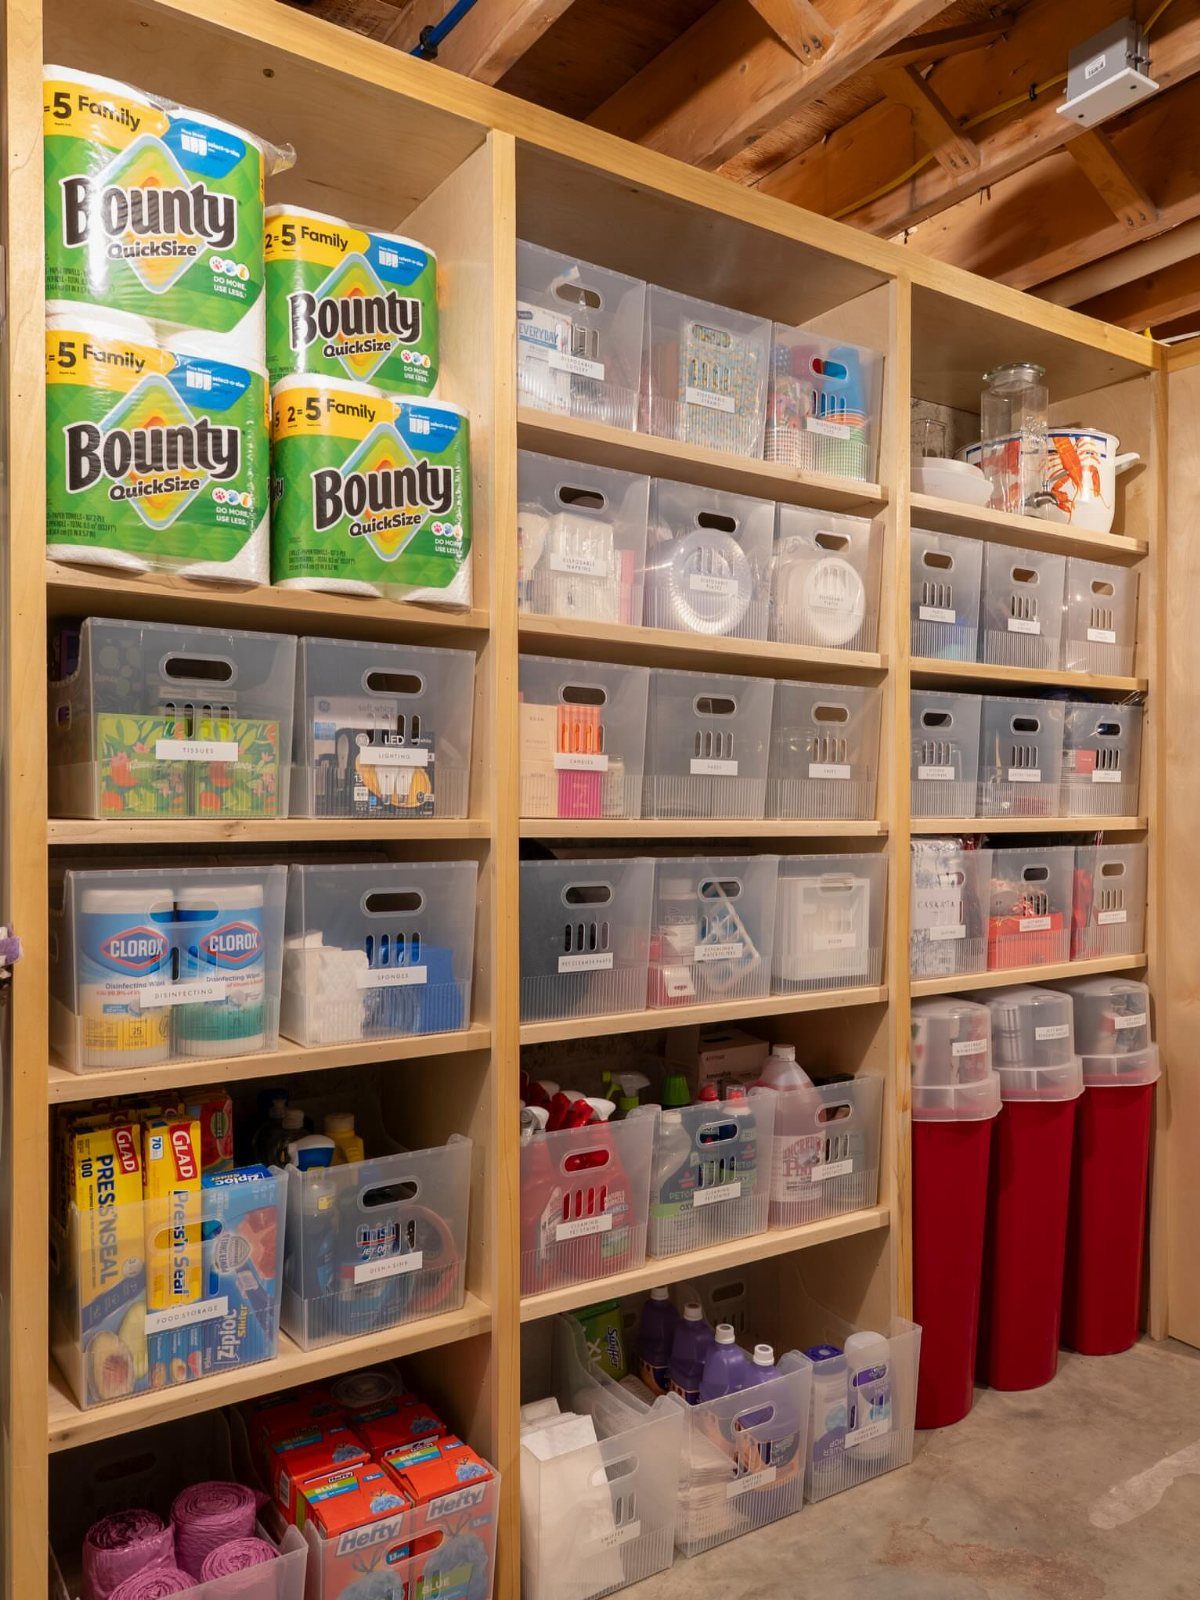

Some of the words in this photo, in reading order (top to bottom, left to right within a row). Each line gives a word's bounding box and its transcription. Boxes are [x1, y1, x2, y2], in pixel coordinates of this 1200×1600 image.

[78, 95, 141, 132] Family
[62, 176, 235, 249] Bounty
[301, 226, 349, 252] Family
[108, 240, 198, 259] QuickSize
[213, 276, 225, 285] DO
[213, 285, 227, 294] USE
[289, 290, 420, 350] Bounty
[519, 323, 559, 345] EVERYDAY
[83, 344, 145, 374] Family
[323, 340, 391, 358] QuickSize
[326, 398, 376, 423] Family
[67, 418, 239, 491] Bounty
[110, 477, 200, 500] QuickSize
[313, 460, 452, 530] Bounty
[216, 506, 227, 515] DO
[216, 515, 229, 524] USE
[349, 512, 422, 537] QuickSize
[384, 734, 404, 745] LED
[110, 938, 164, 958] CLOROX
[209, 932, 258, 952] CLOROX
[105, 982, 147, 990] Disinfecting
[377, 973, 409, 981] SPONGES
[154, 988, 213, 999] DISINFECTING
[116, 1130, 136, 1172] GLAD
[151, 1137, 162, 1150] 70
[172, 1130, 194, 1179] GLAD
[81, 1158, 93, 1178] 100
[370, 1265, 386, 1274] DISH
[156, 1314, 180, 1325] FOOD
[181, 1304, 218, 1320] STORAGE
[315, 1483, 338, 1494] BLUE
[430, 1488, 482, 1518] Hefty
[340, 1520, 401, 1550] Hefty
